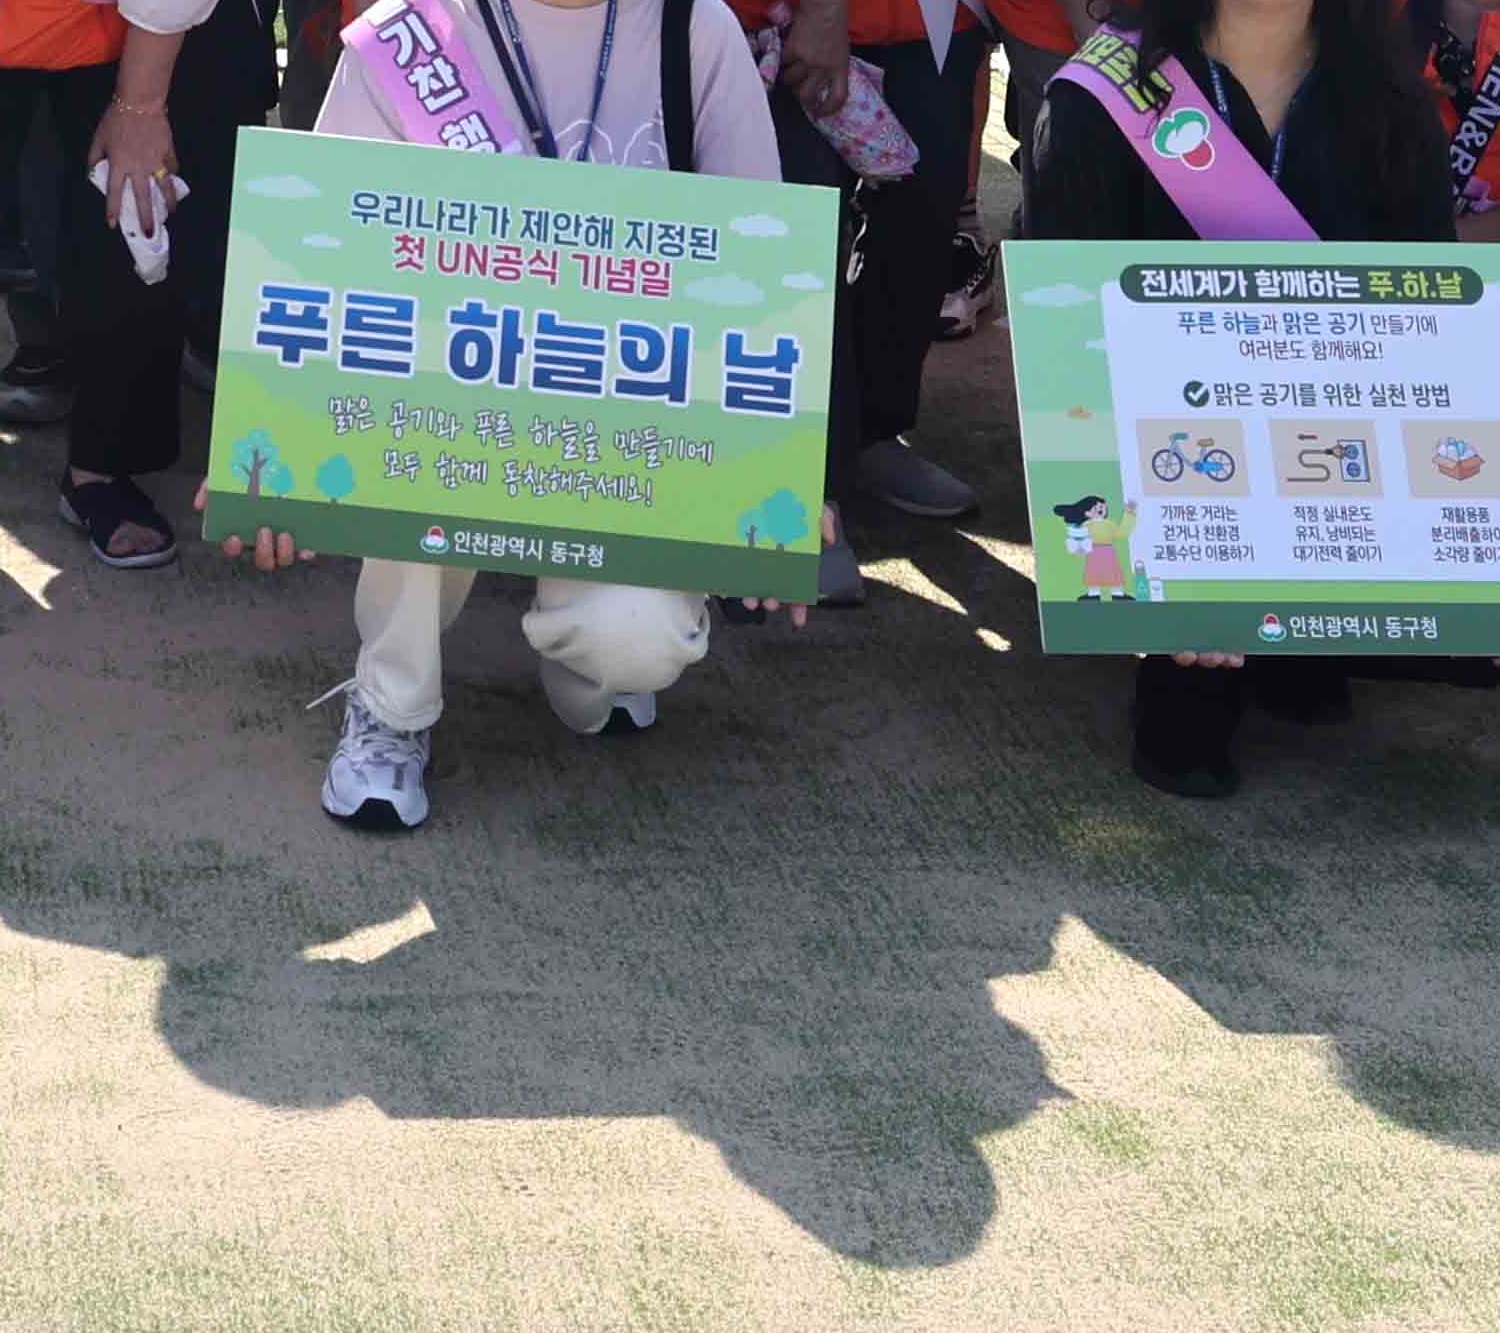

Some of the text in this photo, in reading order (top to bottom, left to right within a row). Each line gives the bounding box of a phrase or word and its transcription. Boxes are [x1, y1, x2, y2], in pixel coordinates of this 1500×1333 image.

[349, 190, 719, 263] 우리나라가 제안해 지정된
[391, 234, 672, 300] 첫 UN공식 기념일
[1139, 268, 1466, 301] 전세계가 함께하는 푸.하.날
[1177, 311, 1439, 336] 푸른 하늘과 맑은 공기 만들기에
[251, 281, 802, 420] 푸른 하늘의 날
[1237, 339, 1385, 361] 여러분도 함께해요!
[1213, 381, 1452, 408] 맑은 공기를 위한 실천 방법
[453, 530, 604, 569] 인천광역시 동구청
[1288, 614, 1439, 640] 인천광역시 동구청
